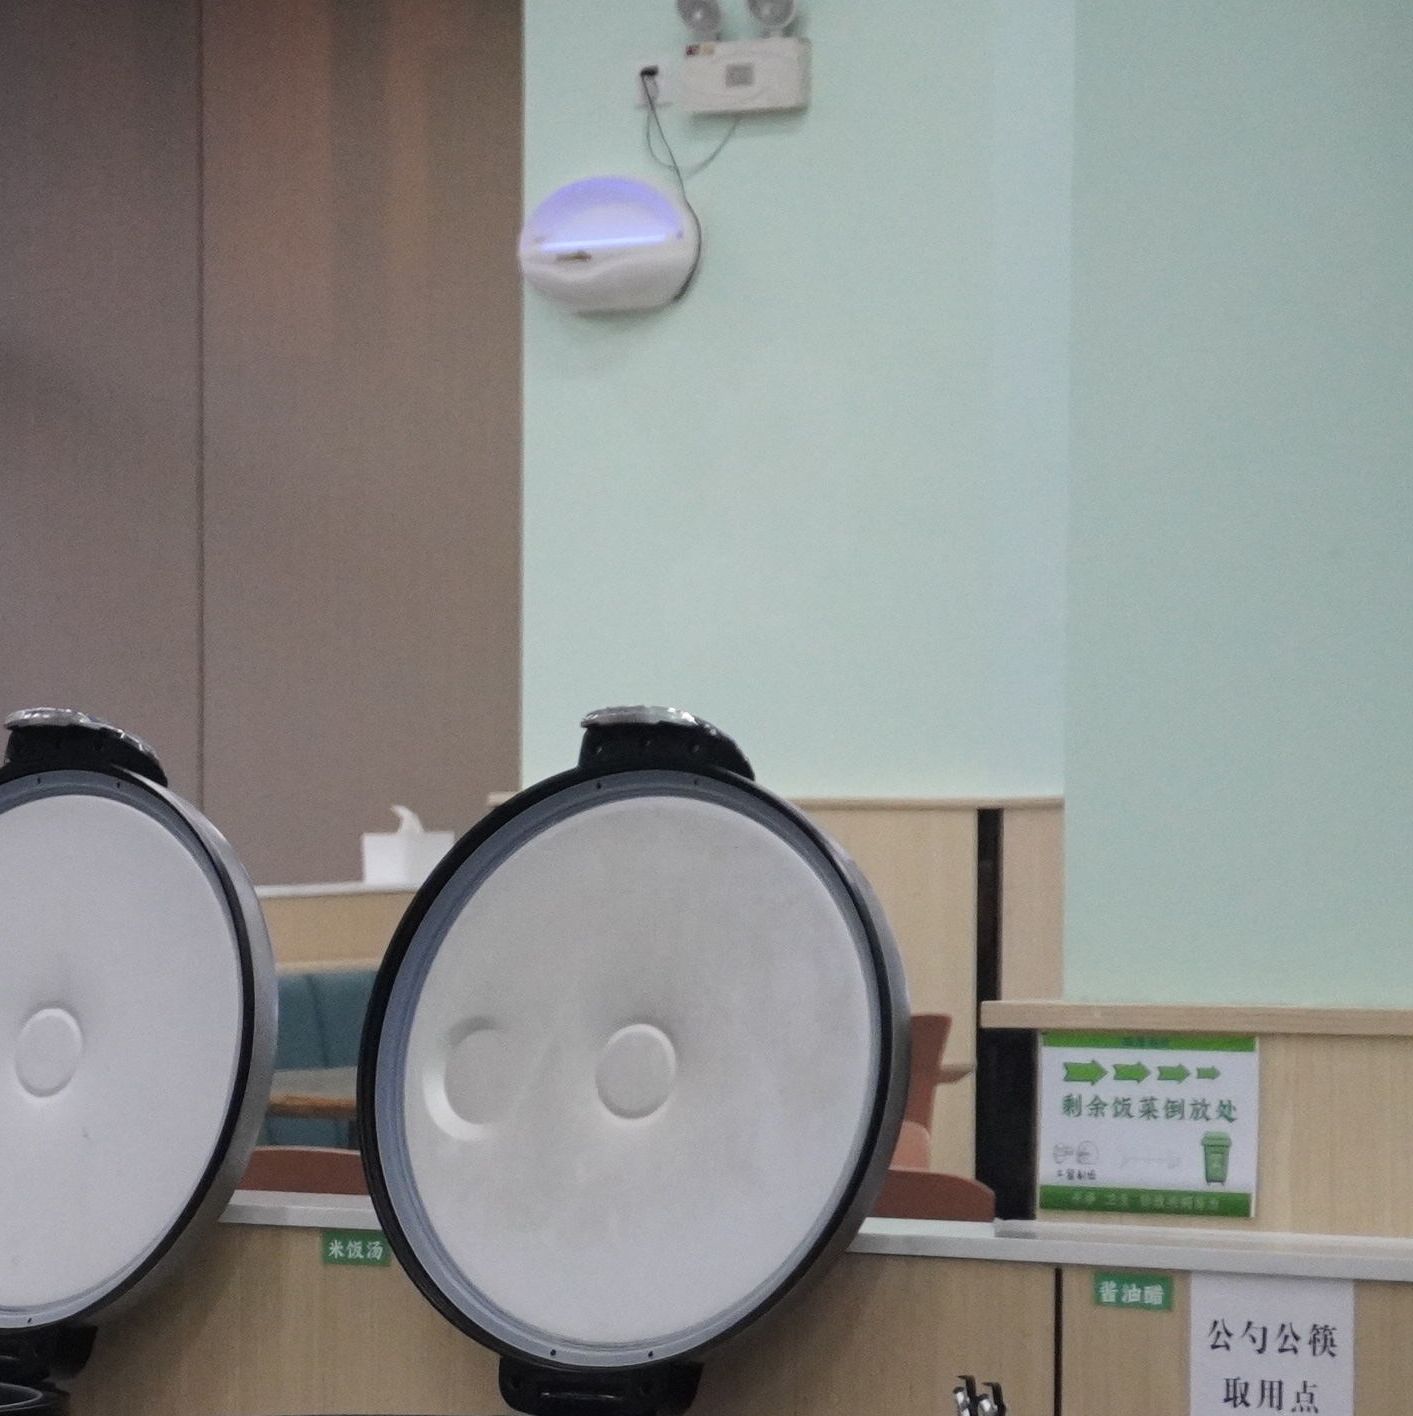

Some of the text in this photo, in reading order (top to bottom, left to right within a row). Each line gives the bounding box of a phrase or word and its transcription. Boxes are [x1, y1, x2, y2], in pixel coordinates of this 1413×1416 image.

[1061, 1093, 1238, 1123] 剩余饭菜倒放处
[328, 1240, 384, 1260] 米饭汤
[1099, 1280, 1164, 1305] 酱油醋
[1207, 1318, 1338, 1358] 公勺公筷
[1223, 1376, 1319, 1414] 取用点
